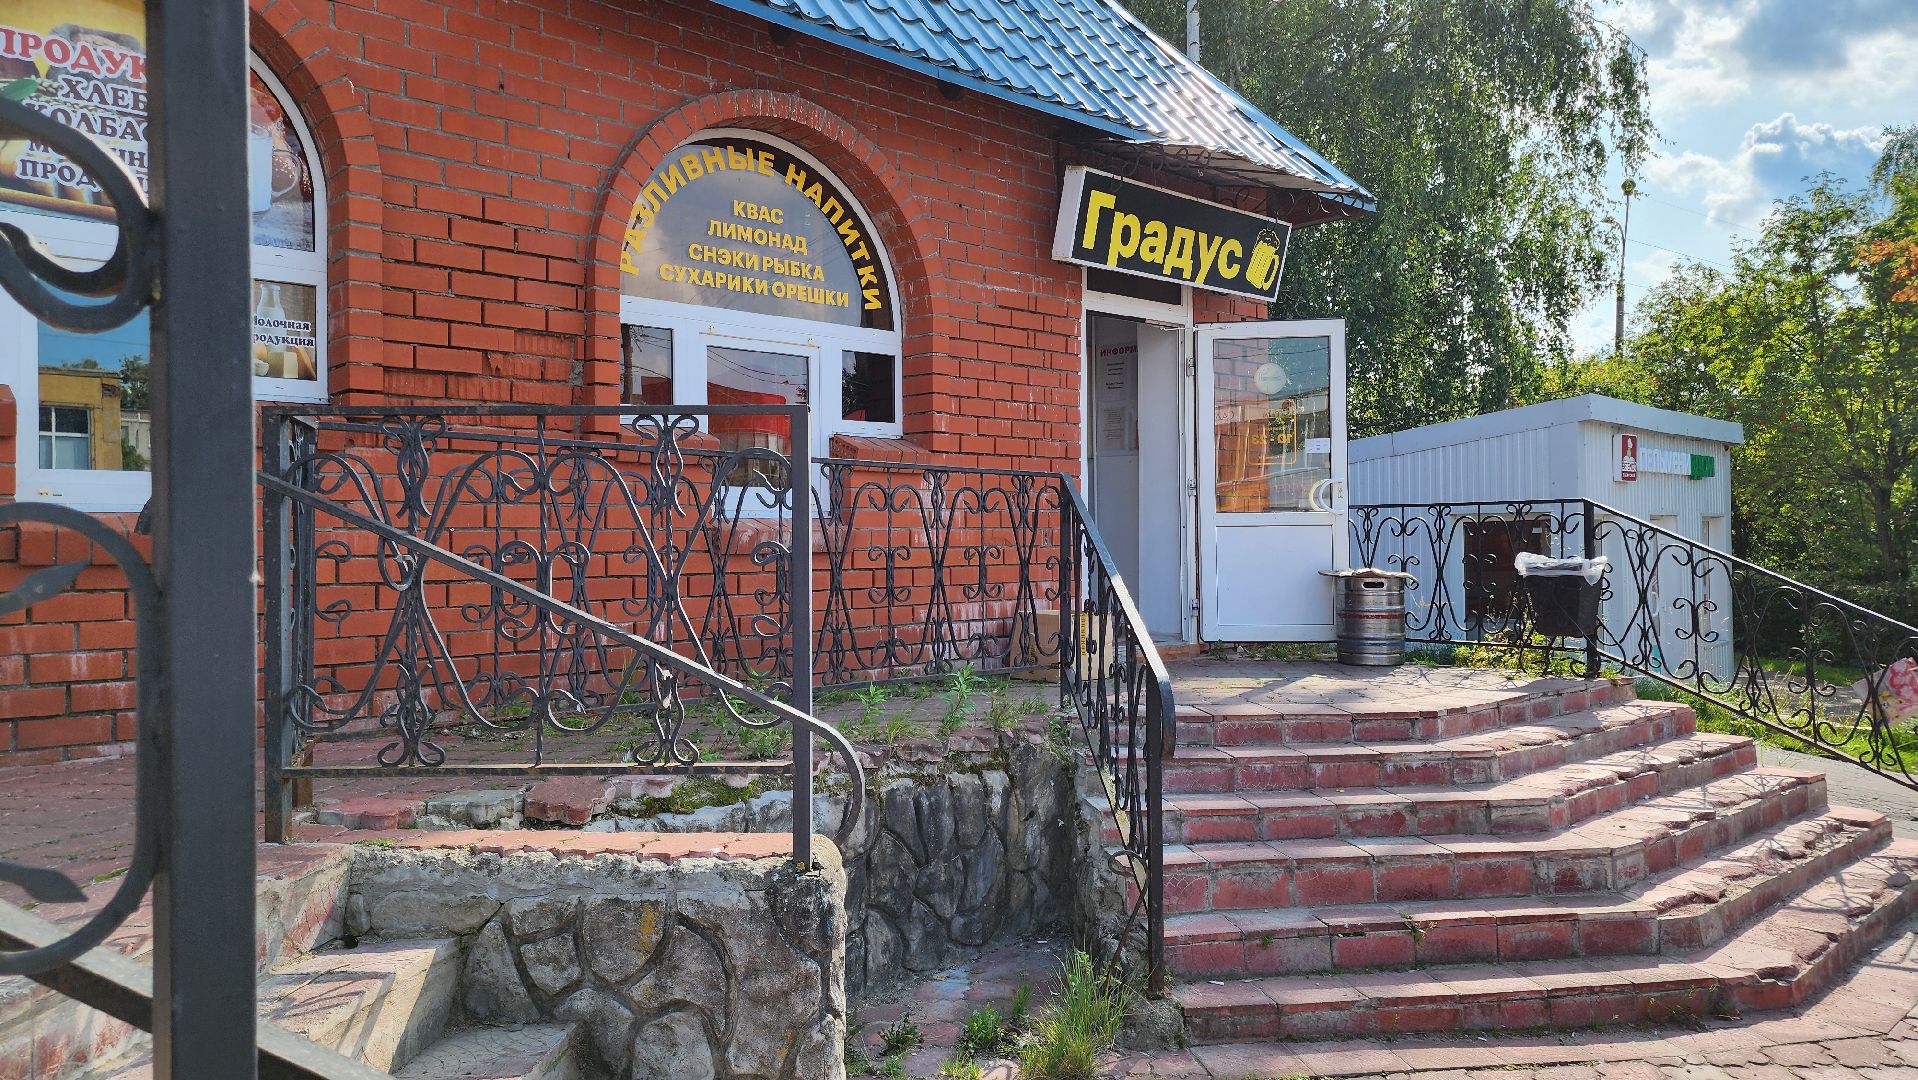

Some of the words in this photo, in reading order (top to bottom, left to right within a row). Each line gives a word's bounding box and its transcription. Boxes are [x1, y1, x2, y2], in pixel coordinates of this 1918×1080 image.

[25, 102, 147, 141] ОЛБА
[620, 145, 775, 276] РАЗЛИВНЫЕ
[785, 163, 882, 310] НАПИТКИ
[733, 199, 784, 225] КВАС
[707, 219, 808, 256] ЛИМОНАД
[1081, 189, 1243, 285] Градус
[688, 243, 759, 271] СНЭКИ
[762, 255, 825, 282] РЫБКА
[658, 263, 769, 296] СУХАРИКИ
[771, 281, 849, 308] ОРЕШКИ
